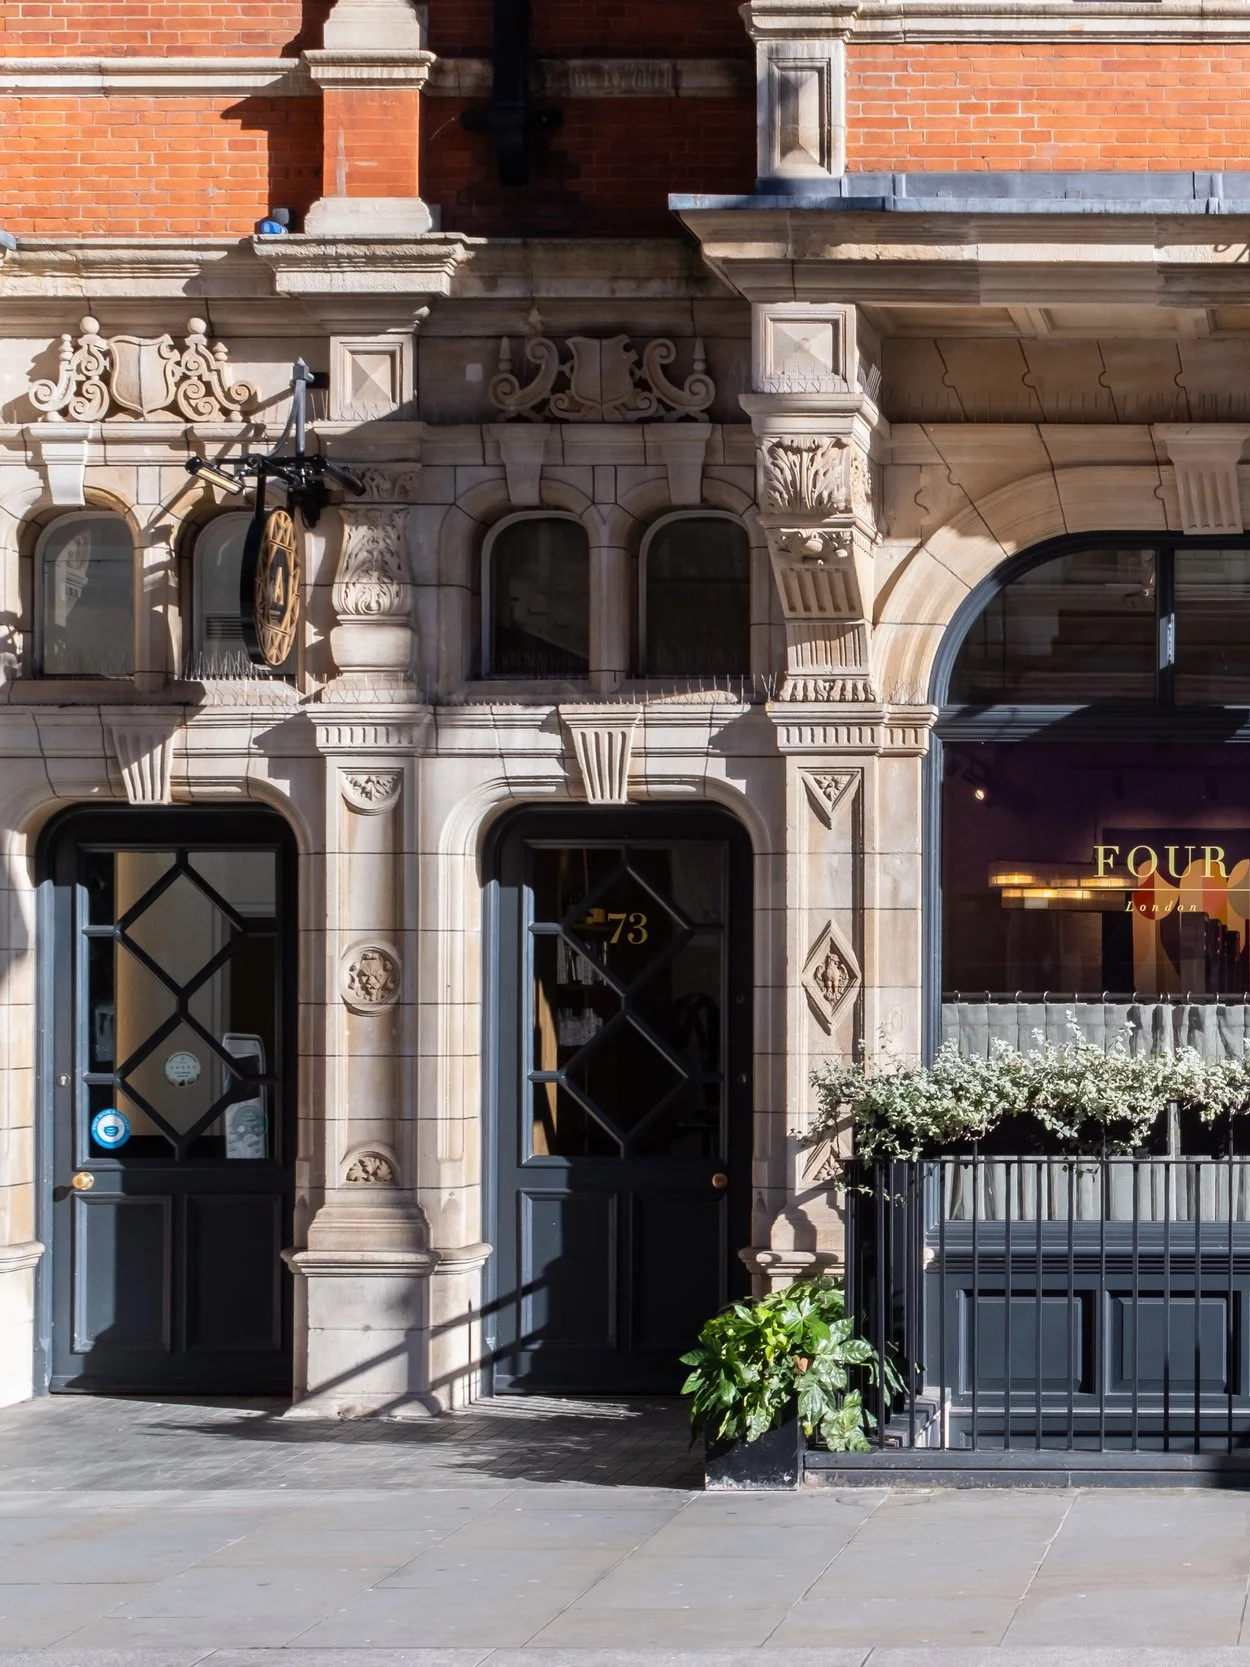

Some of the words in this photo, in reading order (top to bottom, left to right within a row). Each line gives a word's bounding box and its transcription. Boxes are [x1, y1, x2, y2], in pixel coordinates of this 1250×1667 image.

[1093, 844, 1232, 879] FOUR
[1124, 900, 1198, 913] London
[607, 912, 649, 945] 73
